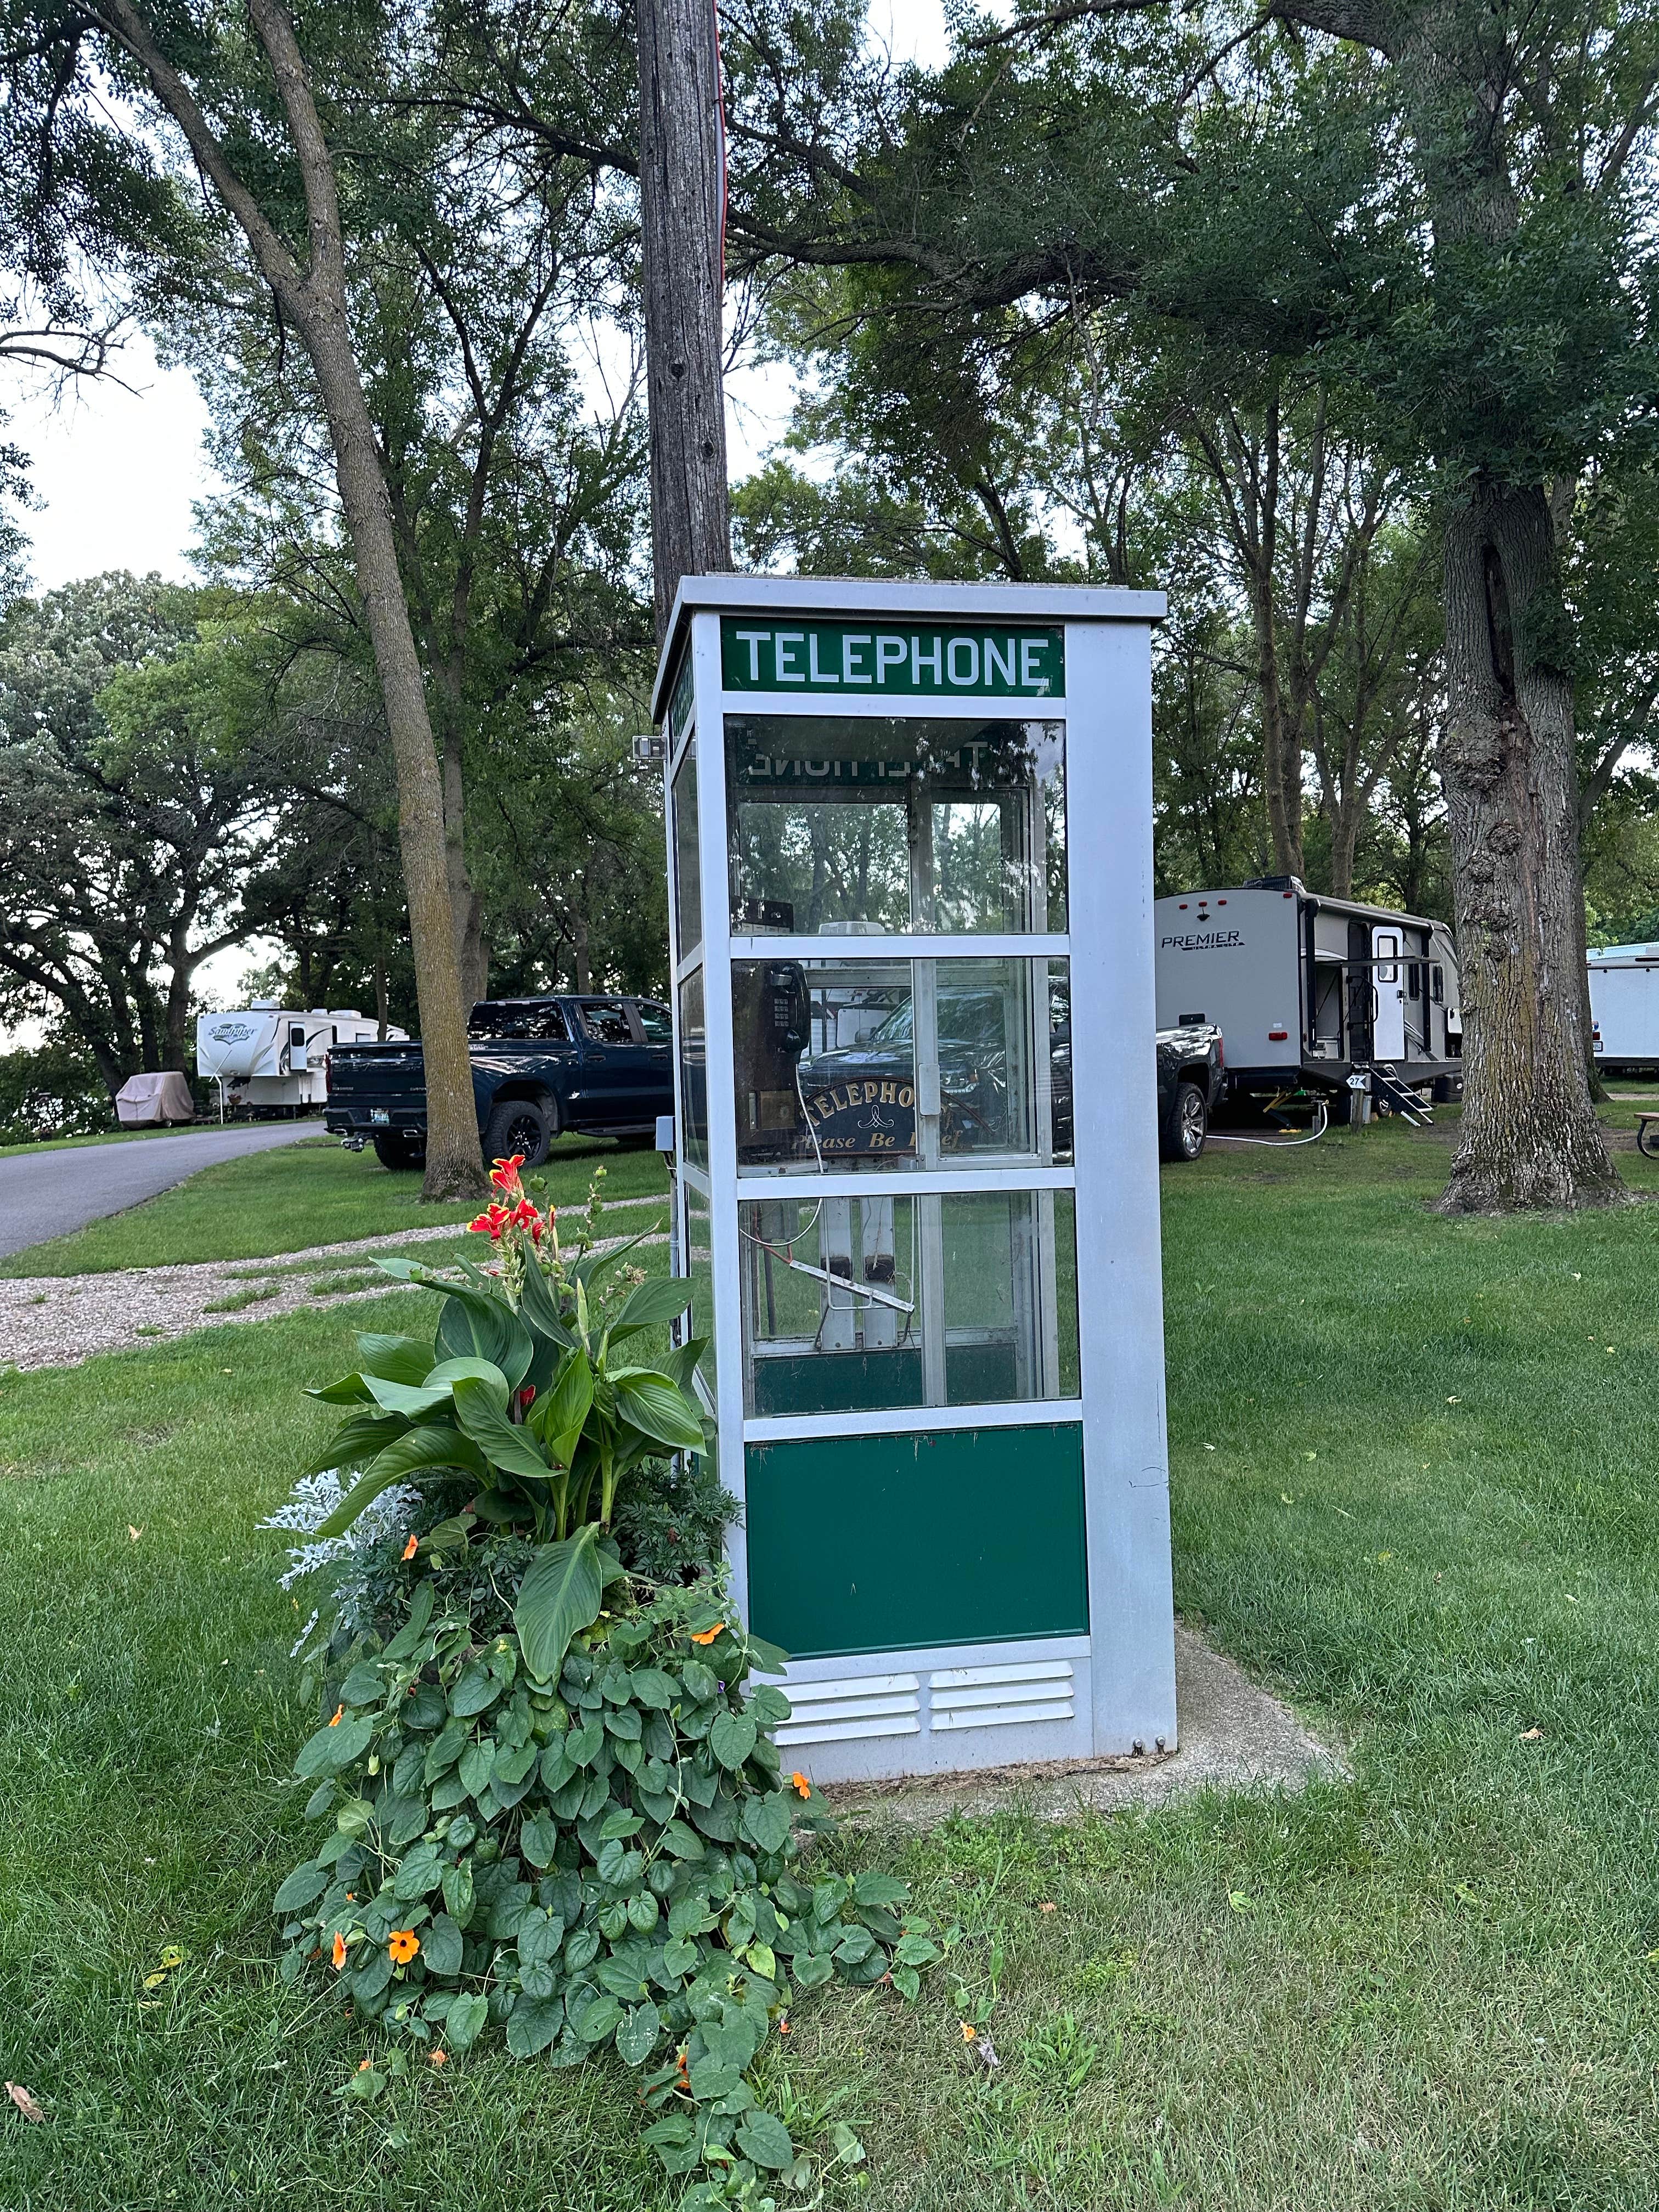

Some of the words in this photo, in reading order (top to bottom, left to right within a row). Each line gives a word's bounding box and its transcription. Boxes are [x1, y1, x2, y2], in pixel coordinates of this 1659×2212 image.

[736, 631, 1049, 687] TELEPHONE
[1161, 930, 1240, 949] PREMIER
[208, 1025, 258, 1037] Sandpiper
[799, 1081, 953, 1130] TELEPHO
[790, 1134, 856, 1150] Please
[868, 1132, 895, 1148] Be
